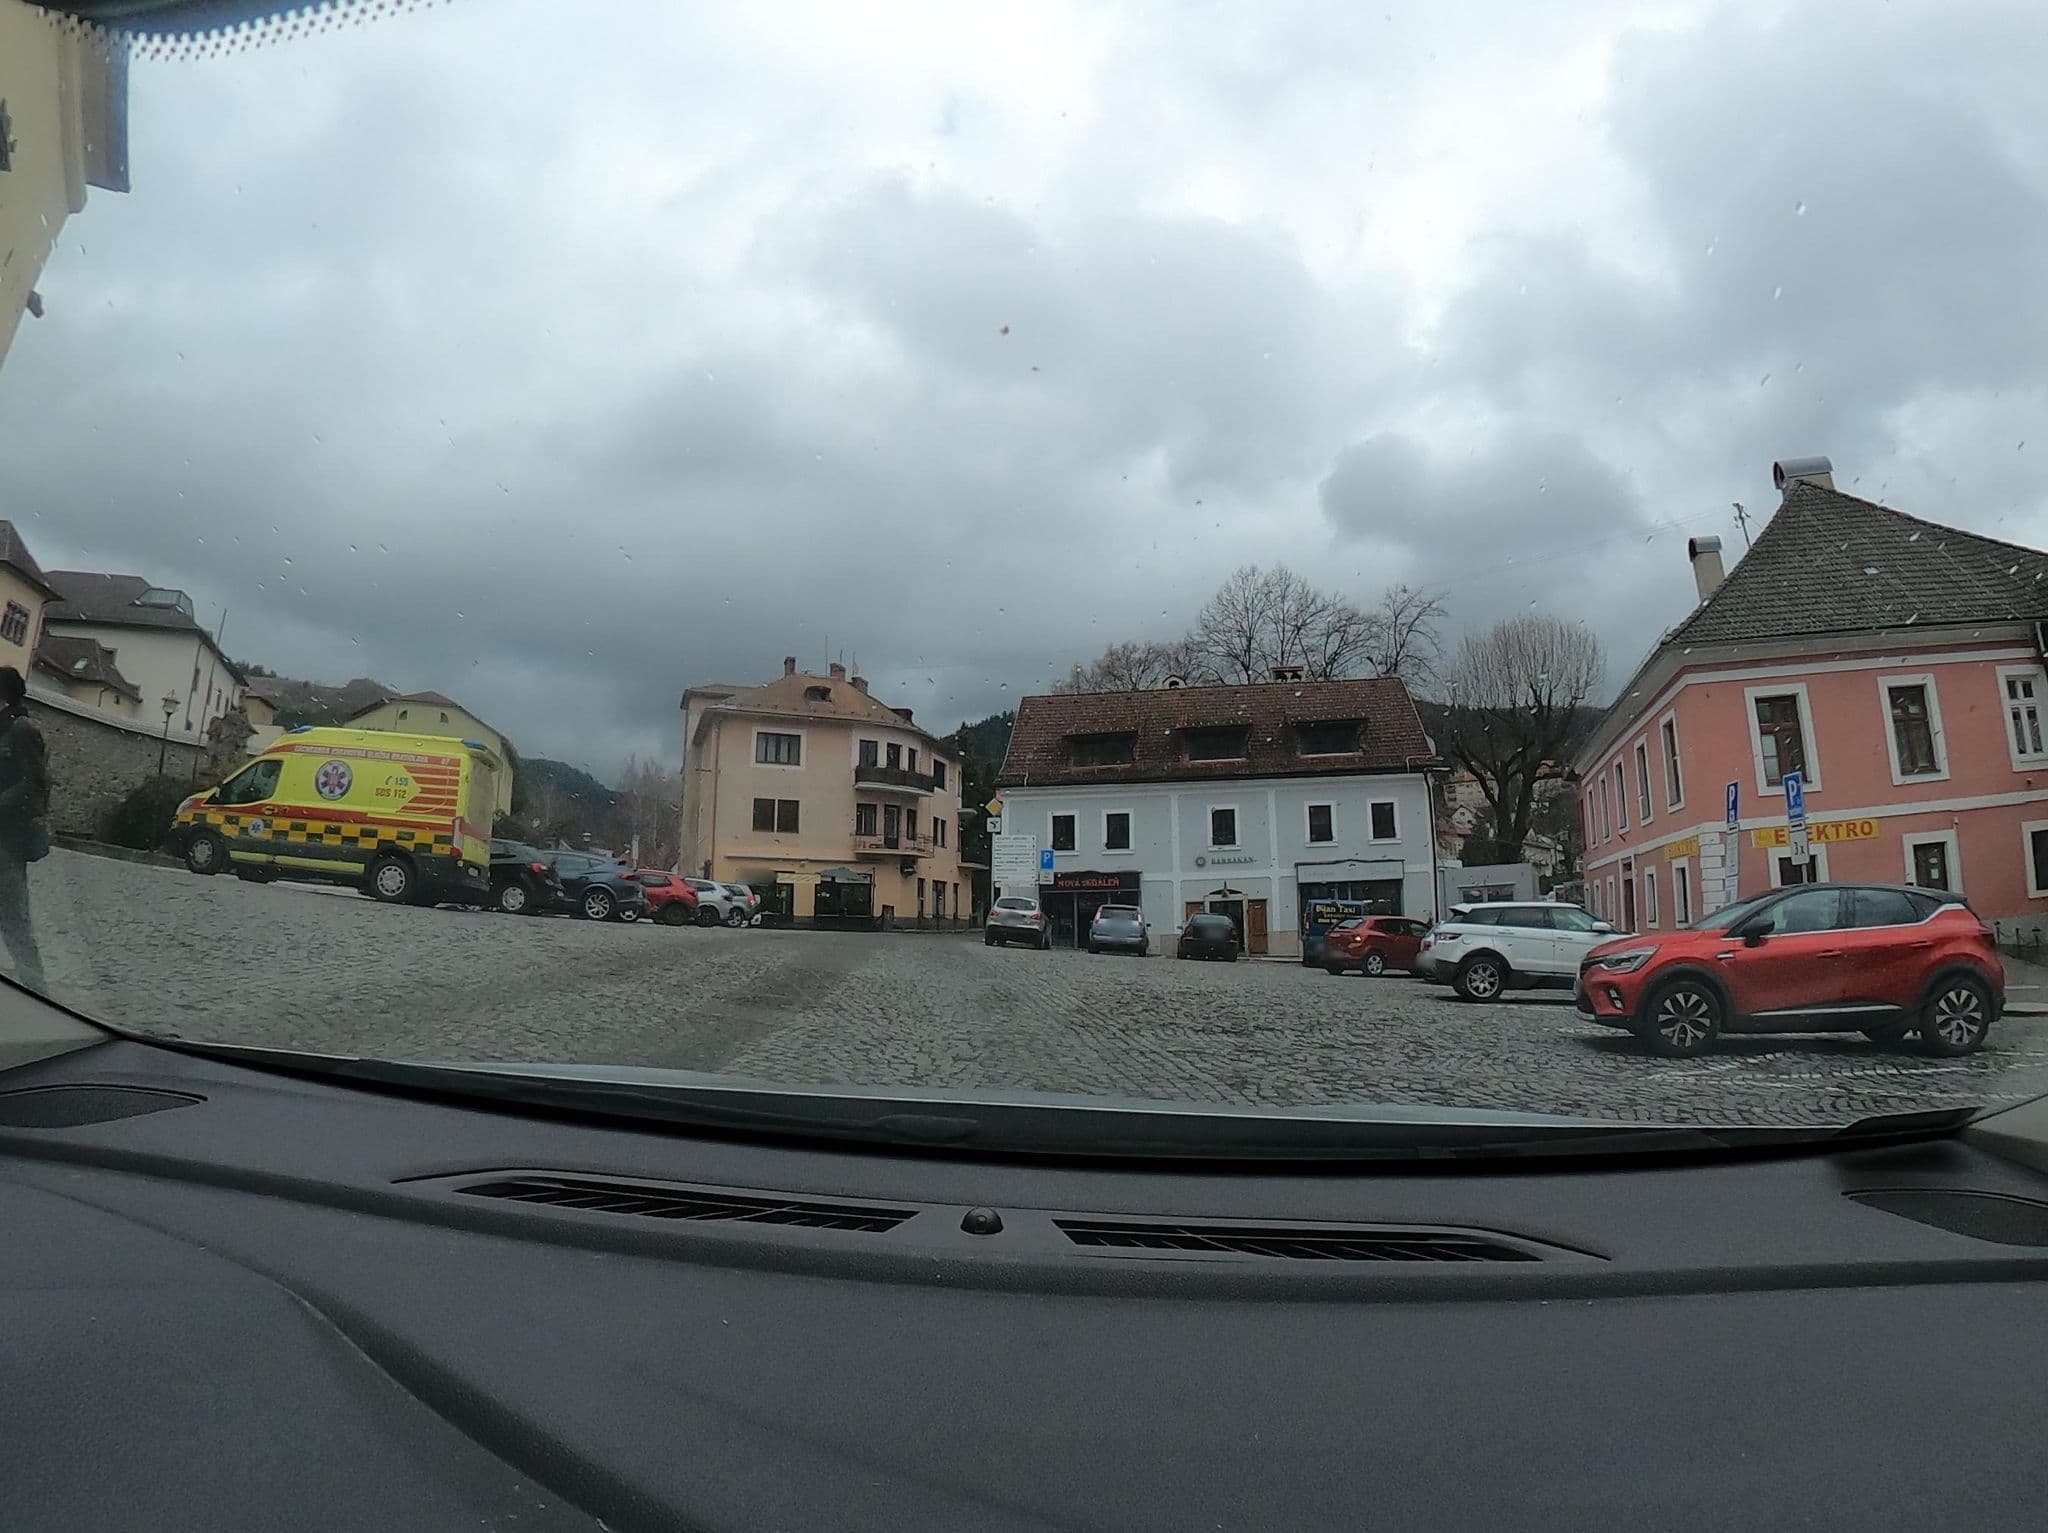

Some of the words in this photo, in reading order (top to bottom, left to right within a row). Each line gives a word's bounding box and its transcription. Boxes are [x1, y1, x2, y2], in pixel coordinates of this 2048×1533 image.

[394, 776, 409, 786] 155
[375, 787, 391, 798] SOS
[394, 789, 407, 799] 112
[1728, 785, 1735, 810] P
[1788, 780, 1798, 806] P
[1774, 821, 1873, 843] EEKTRO
[1339, 905, 1356, 914] Taxi
